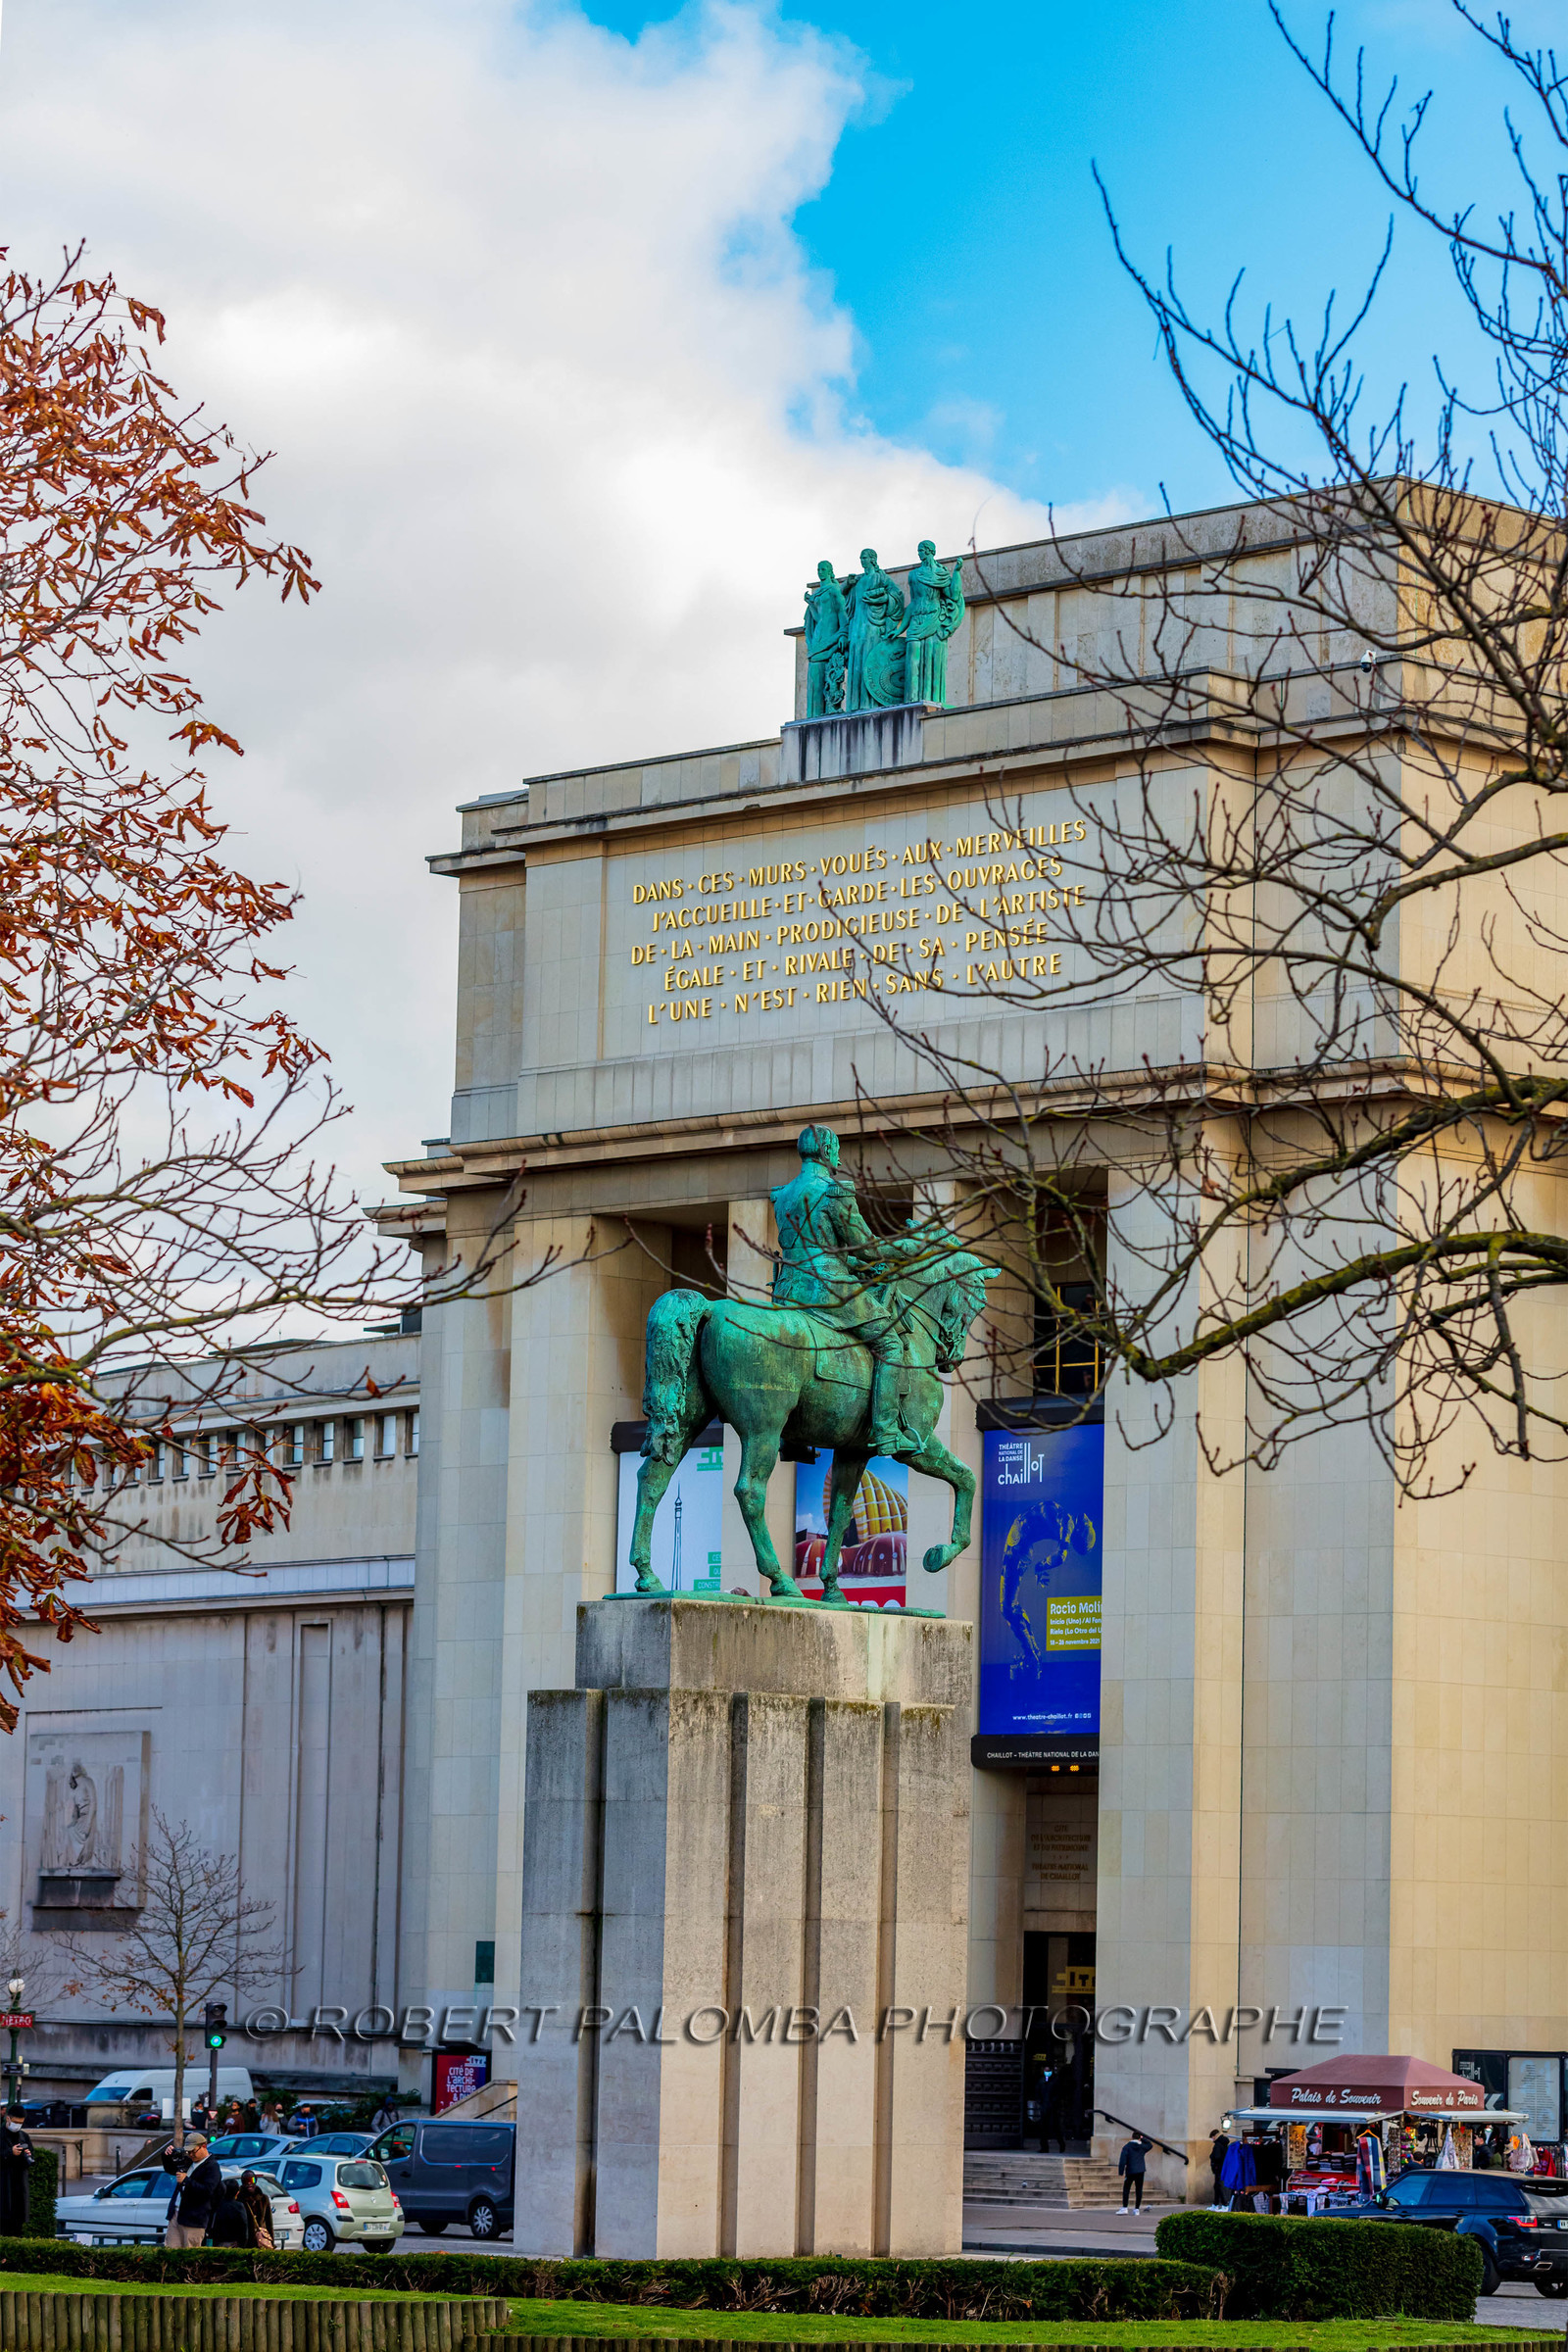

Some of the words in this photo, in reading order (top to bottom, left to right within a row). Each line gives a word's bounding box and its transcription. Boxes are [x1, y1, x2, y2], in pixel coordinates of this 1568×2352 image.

[633, 878, 684, 905] DANS
[698, 871, 734, 895] CES
[749, 860, 807, 887] MURS
[819, 845, 887, 876] VOUÉS
[902, 840, 943, 865] AUX
[956, 819, 1086, 858] MERVEILLES
[652, 897, 772, 932] J'ACCUEILLE
[784, 891, 807, 913] ET
[818, 880, 888, 908] GARDE
[900, 873, 936, 898] LES
[947, 856, 1062, 891] OUVRAGES
[631, 943, 657, 965] DE
[671, 939, 694, 959] LA
[709, 929, 760, 955] MAIN
[777, 907, 919, 945] PRODIGIEUSE
[936, 902, 963, 924] DE
[664, 965, 724, 991] ÉGALE
[743, 959, 766, 982] ET
[785, 948, 854, 976] RIVALE
[873, 942, 900, 964] DE
[919, 937, 946, 958] SA
[965, 918, 1048, 953] PENSÉE
[648, 997, 712, 1024] L'UNE
[735, 986, 797, 1012] N'EST
[816, 978, 866, 1004] RIEN
[885, 968, 944, 995] SANS
[1051, 1601, 1076, 1614] Rocío
[1291, 2087, 1322, 2103] Palais
[1325, 2089, 1337, 2104] de
[1340, 2088, 1382, 2105] Souvenir
[1410, 2090, 1443, 2106] Souvenir
[1446, 2092, 1454, 2106] de
[1457, 2089, 1479, 2106] Paris
